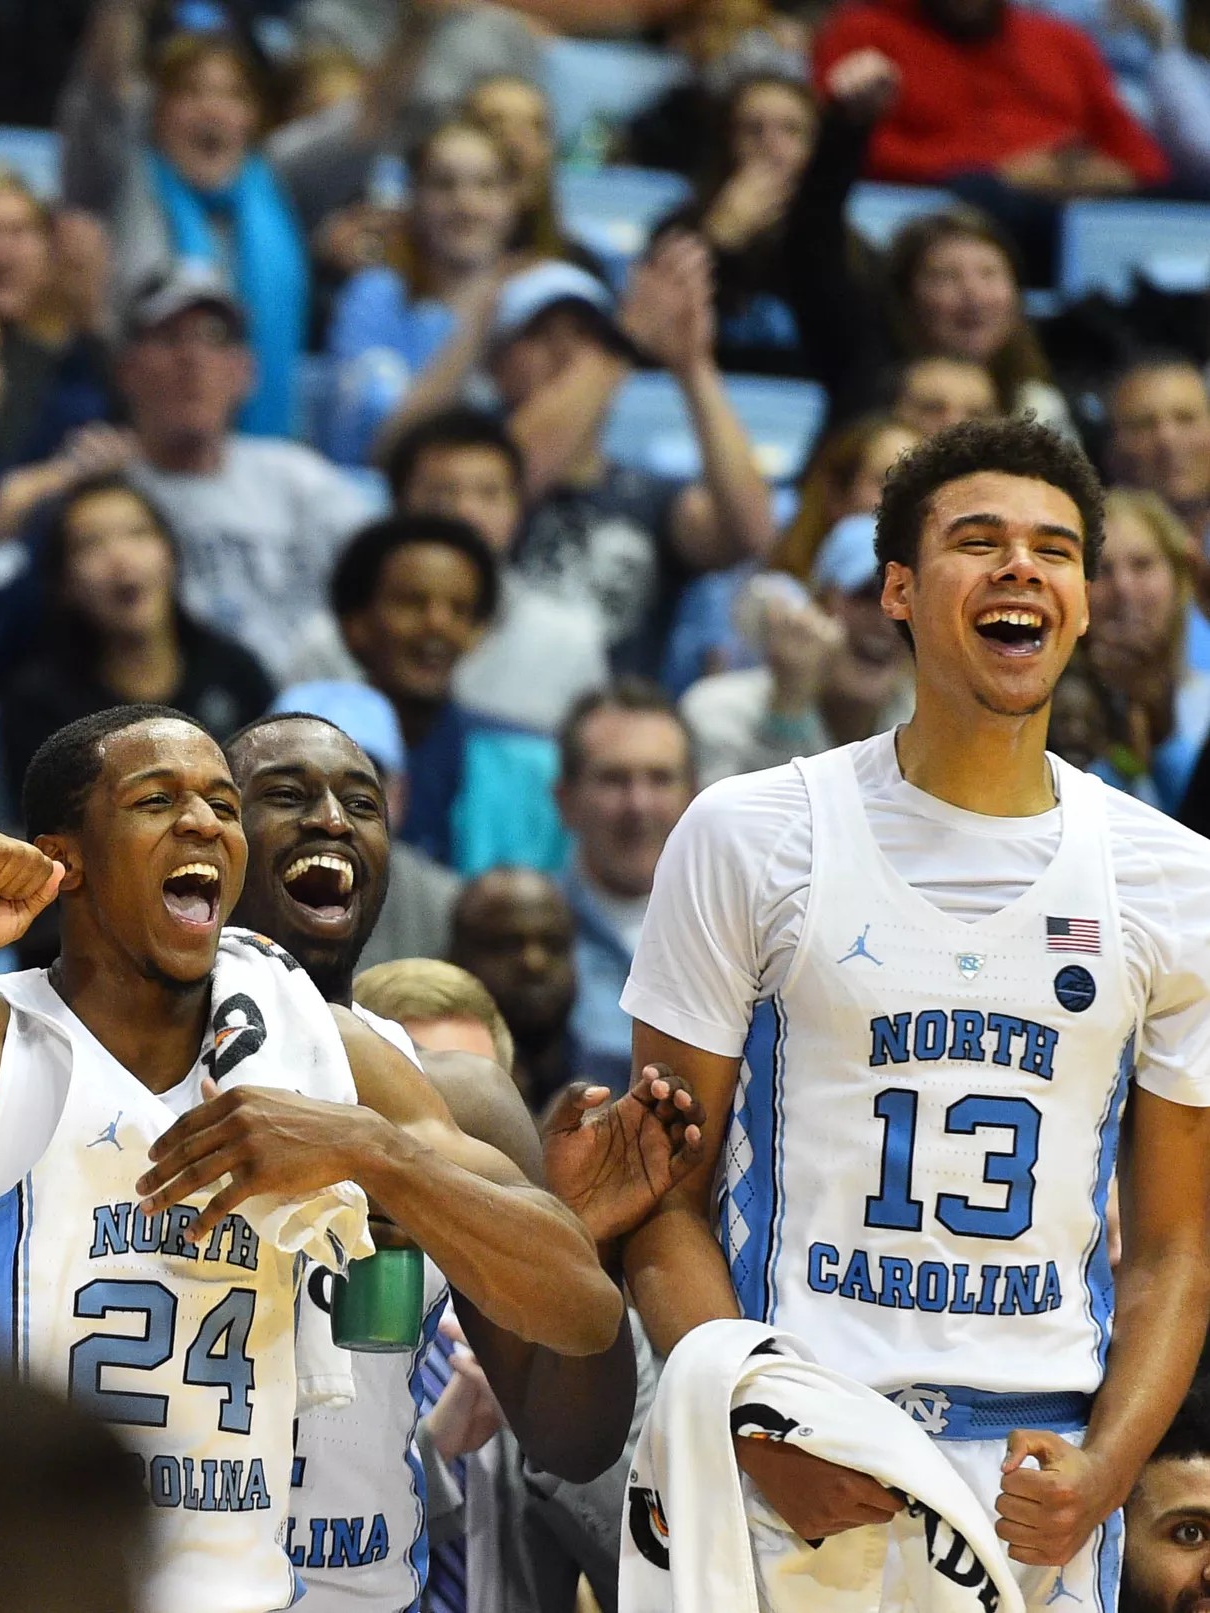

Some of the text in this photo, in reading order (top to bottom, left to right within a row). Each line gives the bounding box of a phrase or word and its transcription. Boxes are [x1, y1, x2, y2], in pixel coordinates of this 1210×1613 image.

[869, 1009, 1059, 1081] NORTH
[864, 1088, 1042, 1241] 13
[807, 1242, 1062, 1315] CAROLINA
[68, 1278, 257, 1435] 24
[135, 1453, 271, 1512] OLINA
[286, 1513, 390, 1568] LINA
